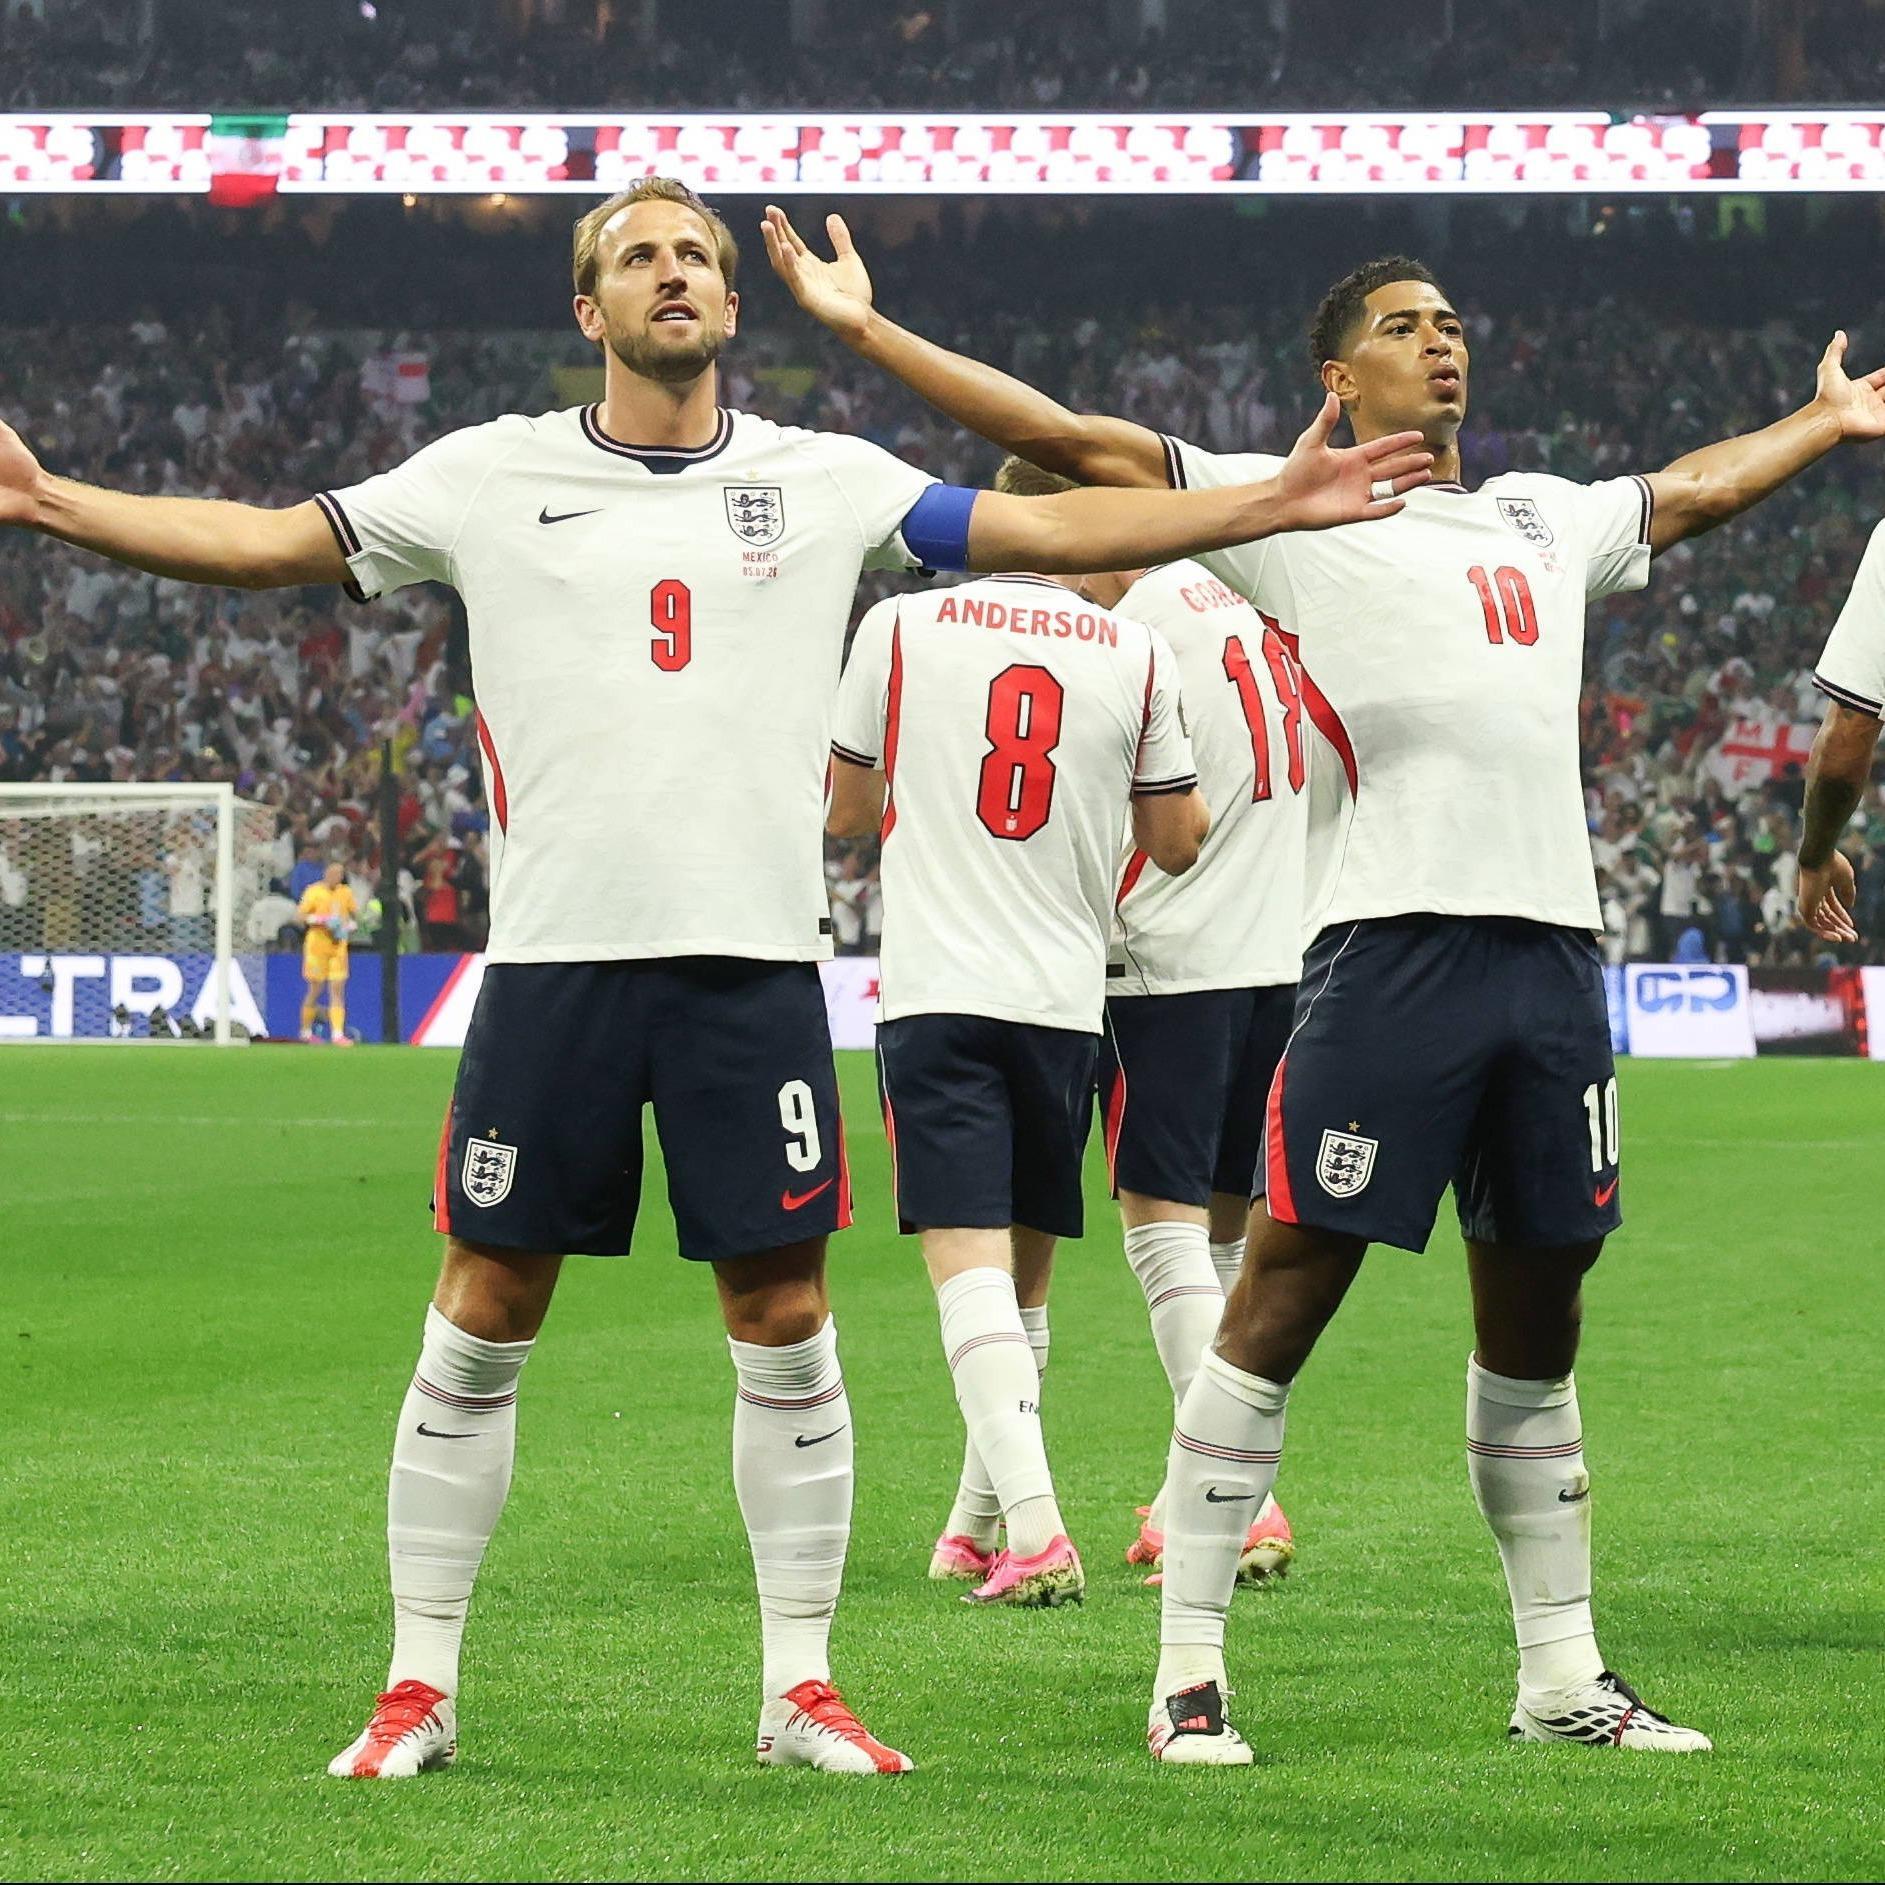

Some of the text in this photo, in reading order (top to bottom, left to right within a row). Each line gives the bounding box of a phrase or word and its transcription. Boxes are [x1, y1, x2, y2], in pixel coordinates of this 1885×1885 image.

[742, 551, 778, 562] MEXICO
[650, 578, 692, 672] 9
[936, 597, 1118, 649] ANDERSON
[1466, 565, 1540, 646] 10
[976, 663, 1065, 841] 8
[777, 1079, 822, 1172] 9
[1583, 1076, 1619, 1173] 10
